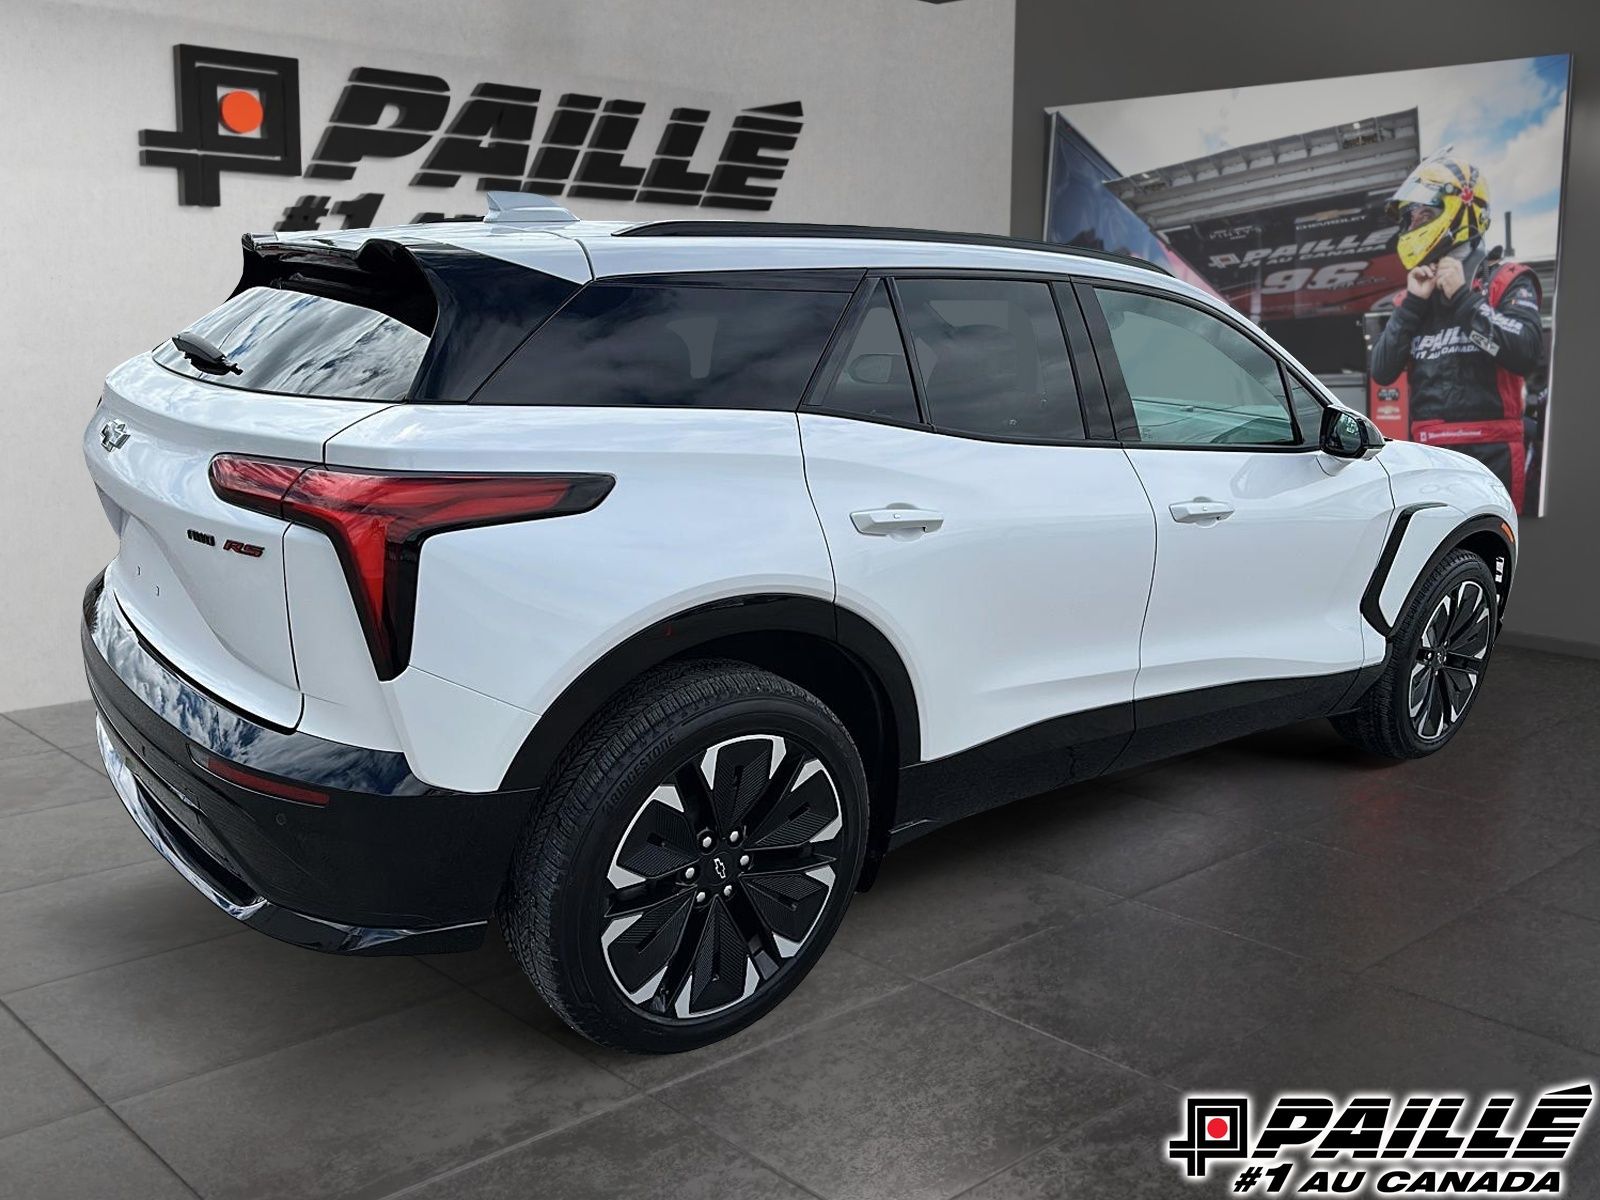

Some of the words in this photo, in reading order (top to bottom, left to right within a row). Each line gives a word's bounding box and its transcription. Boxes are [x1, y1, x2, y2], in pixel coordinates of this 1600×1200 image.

[303, 67, 804, 211] PAILLÉ
[273, 193, 385, 231] #1
[1266, 256, 1293, 265] AU
[1299, 245, 1387, 260] CANADA
[1262, 261, 1370, 294] 96
[223, 539, 265, 558] RS
